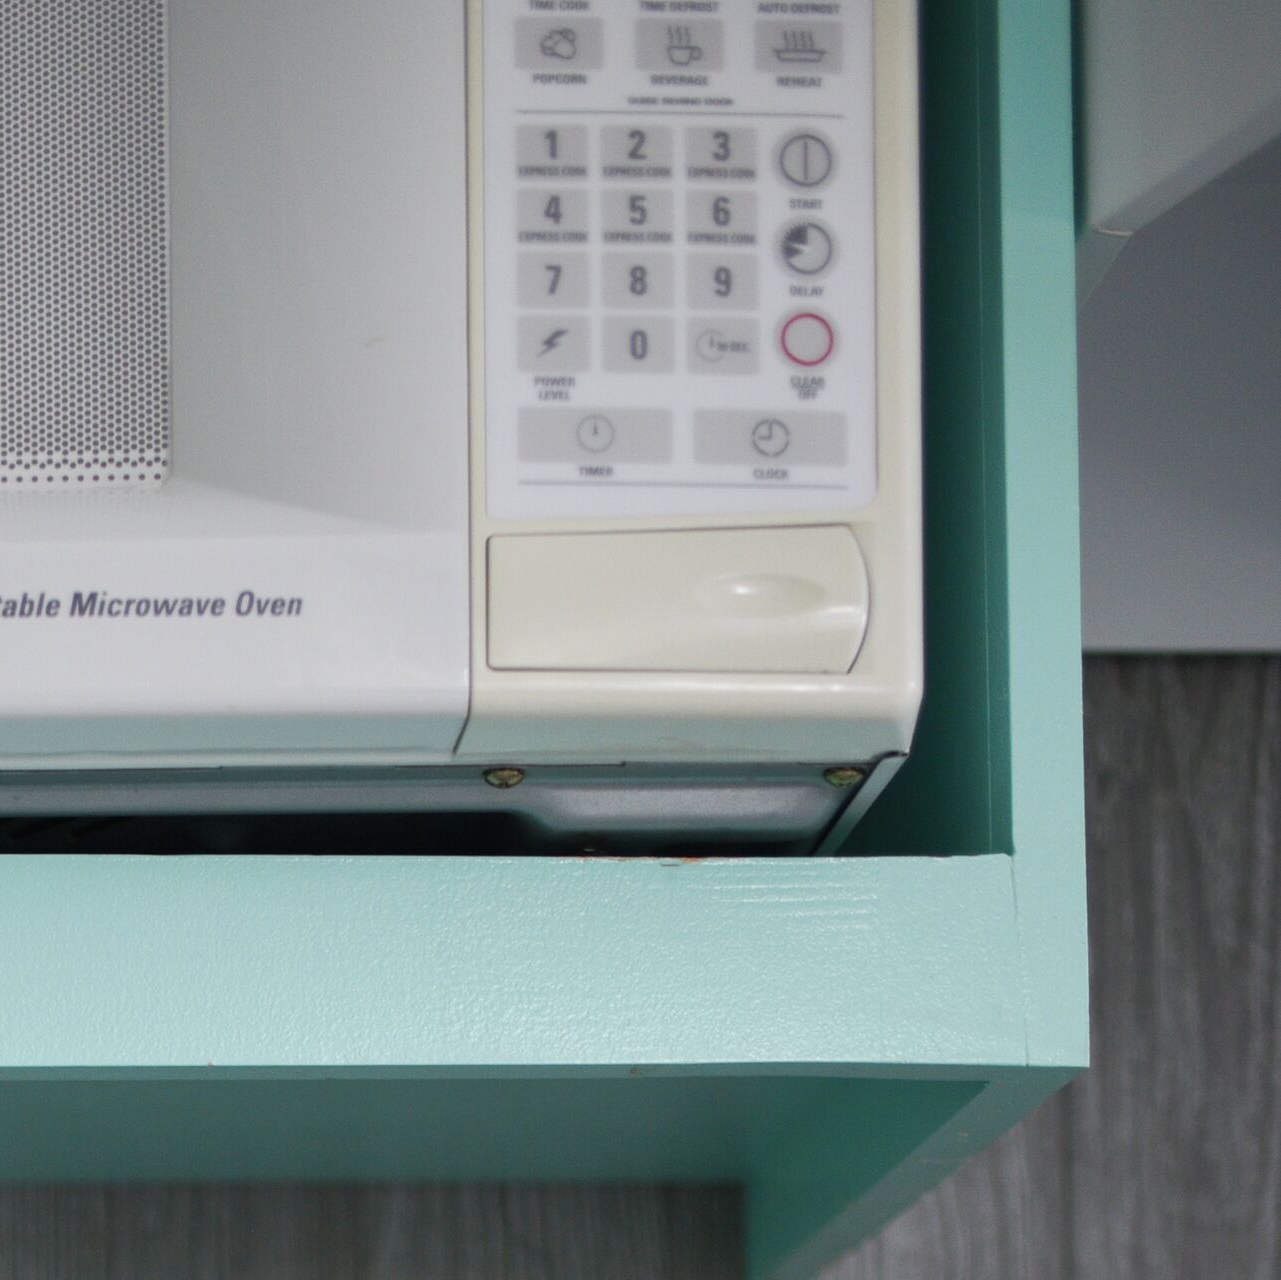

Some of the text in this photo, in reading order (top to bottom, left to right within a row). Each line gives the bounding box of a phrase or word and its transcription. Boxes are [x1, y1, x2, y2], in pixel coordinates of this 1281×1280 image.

[529, 0, 589, 10] TIME COOK
[640, 0, 719, 12] TIME DEFROST
[758, 3, 840, 14] AUTO DEFROST
[533, 73, 587, 85] POPCORN
[650, 75, 709, 87] BEVERAGE
[776, 76, 823, 88] REHEAT
[544, 129, 559, 160] 1
[627, 129, 647, 160] 2
[712, 131, 732, 162] 3
[519, 166, 587, 177] EXPRESS COOK
[604, 166, 672, 177] EXPRESS COOK
[688, 167, 755, 178] EXPRESS COOK
[543, 194, 562, 224] 4
[628, 195, 647, 226] 5
[789, 199, 823, 210] START
[712, 196, 731, 227] 6
[519, 232, 587, 242] EXPRESS COOK
[604, 232, 672, 242] EXPRESS COOK
[688, 233, 755, 244] EXPRESS COOK
[545, 265, 562, 296] 7
[629, 265, 648, 296] 8
[713, 266, 732, 297] 9
[789, 286, 824, 297] DELAY
[629, 328, 648, 361] 0
[534, 375, 576, 387] POWER
[790, 376, 825, 389] CLEAR
[538, 389, 571, 401] LEVEL
[798, 388, 817, 401] OFF
[579, 466, 613, 477] TIMER
[753, 468, 790, 480] CLOCK
[69, 590, 225, 618] Microwave
[235, 589, 303, 617] Oven
